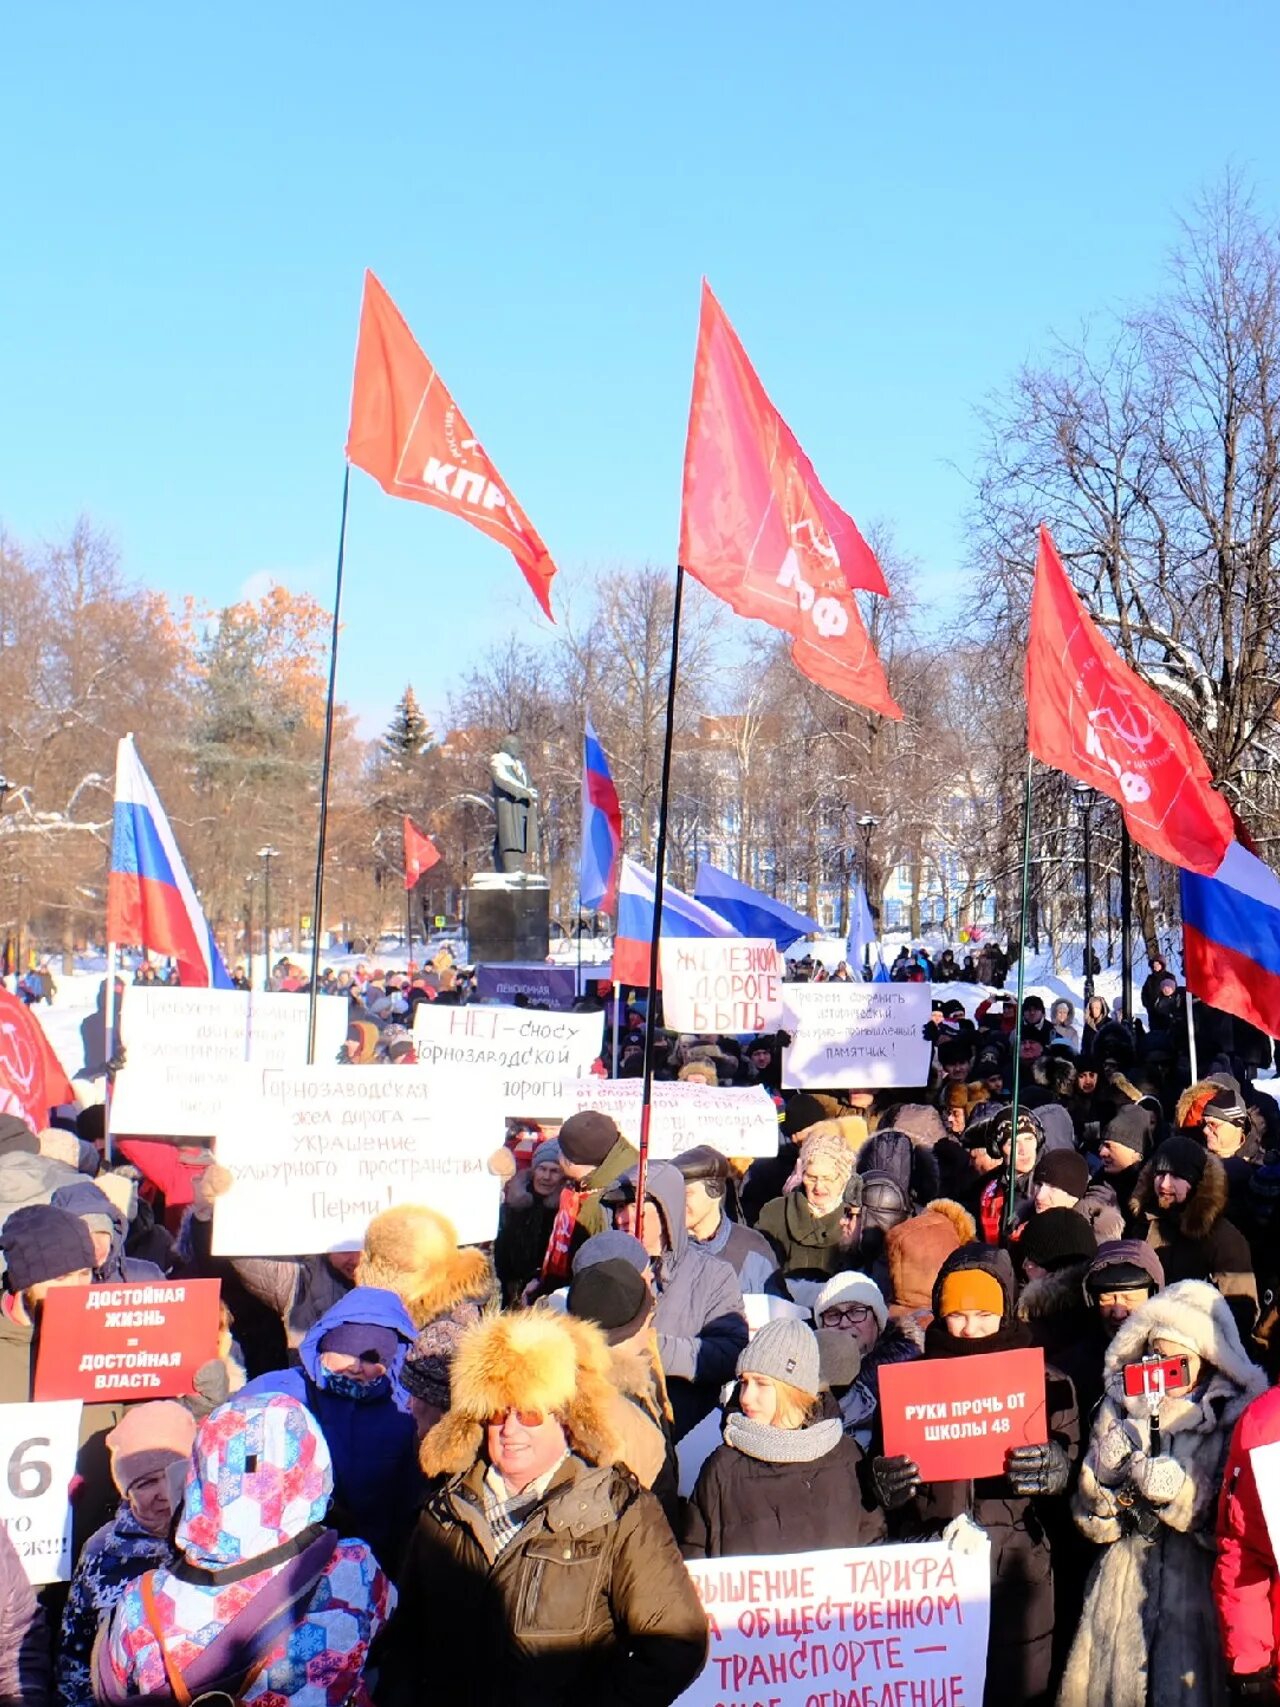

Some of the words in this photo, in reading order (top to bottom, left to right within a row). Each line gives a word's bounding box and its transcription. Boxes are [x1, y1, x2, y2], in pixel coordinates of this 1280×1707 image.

[689, 974, 777, 1005] ДОРОГЕ
[449, 1009, 500, 1039] НЕТ
[693, 1002, 765, 1031] БЫТЬ
[85, 1285, 186, 1310] ДОСТОЙНАЯ
[104, 1310, 166, 1328] ЖИЗНЬ
[78, 1351, 182, 1372] ДОСТОЙНАЯ
[94, 1373, 161, 1389] ВЛАСТЬ
[905, 1403, 948, 1420] РУКИ
[951, 1397, 1003, 1417] ПРОЧЬ
[1007, 1392, 1026, 1410] ОТ
[924, 1420, 987, 1441] ШКОЛЫ
[991, 1418, 1011, 1433] 48
[7, 1437, 52, 1499] 6
[845, 1556, 958, 1600] ТАРИФА
[737, 1593, 964, 1643] ОБЩЕСТВЕННОМ
[711, 1637, 905, 1693] ТРАНСПОРТЕ
